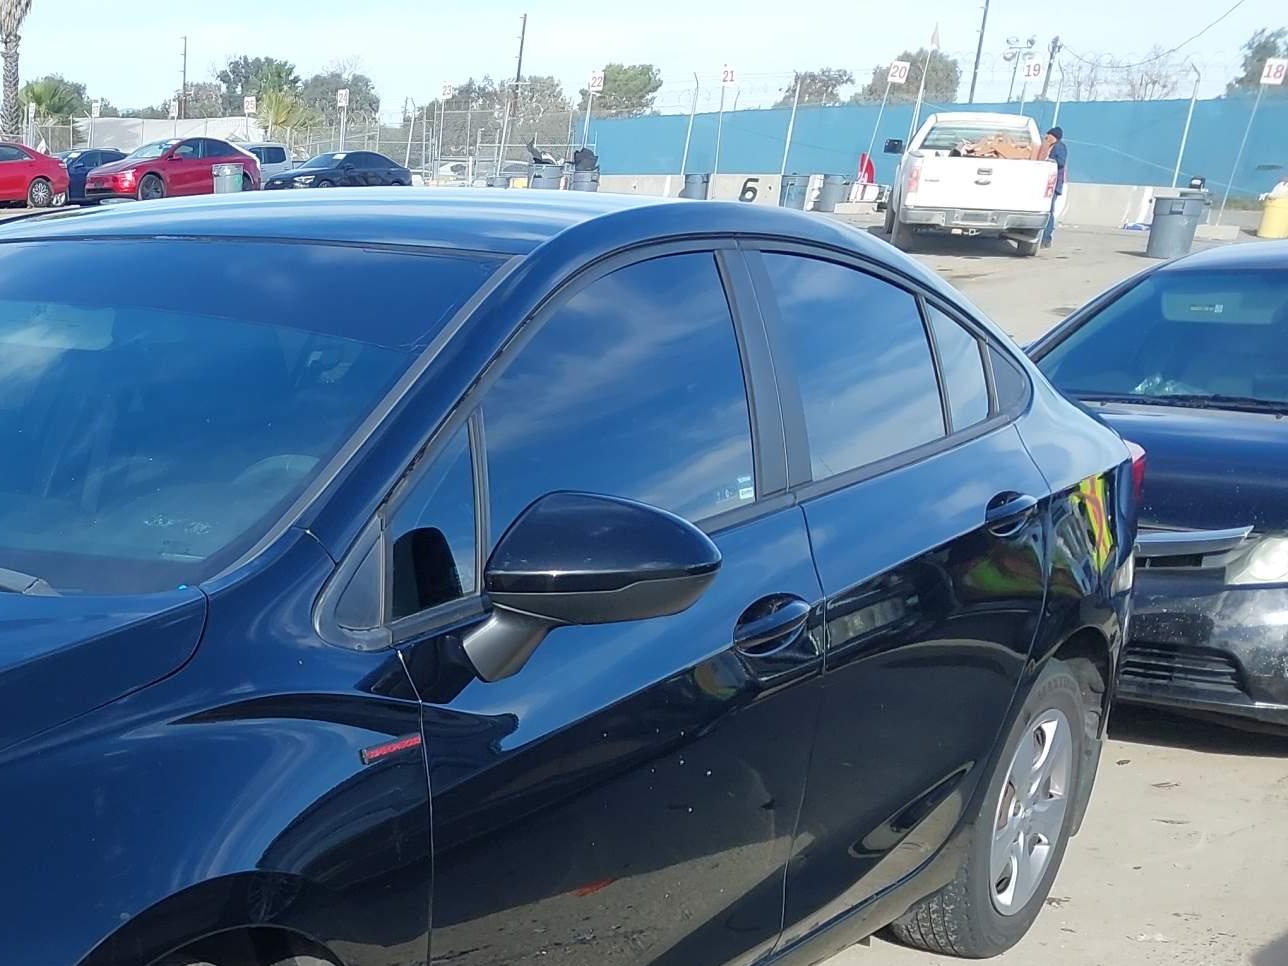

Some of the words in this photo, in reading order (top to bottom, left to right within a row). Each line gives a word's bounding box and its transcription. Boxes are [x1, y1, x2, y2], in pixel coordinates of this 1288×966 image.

[722, 70, 735, 82] 21
[890, 65, 908, 80] 20
[1024, 63, 1041, 77] 19
[1264, 64, 1285, 78] 18
[591, 76, 603, 87] 22
[442, 84, 452, 96] 23
[739, 178, 759, 202] 6
